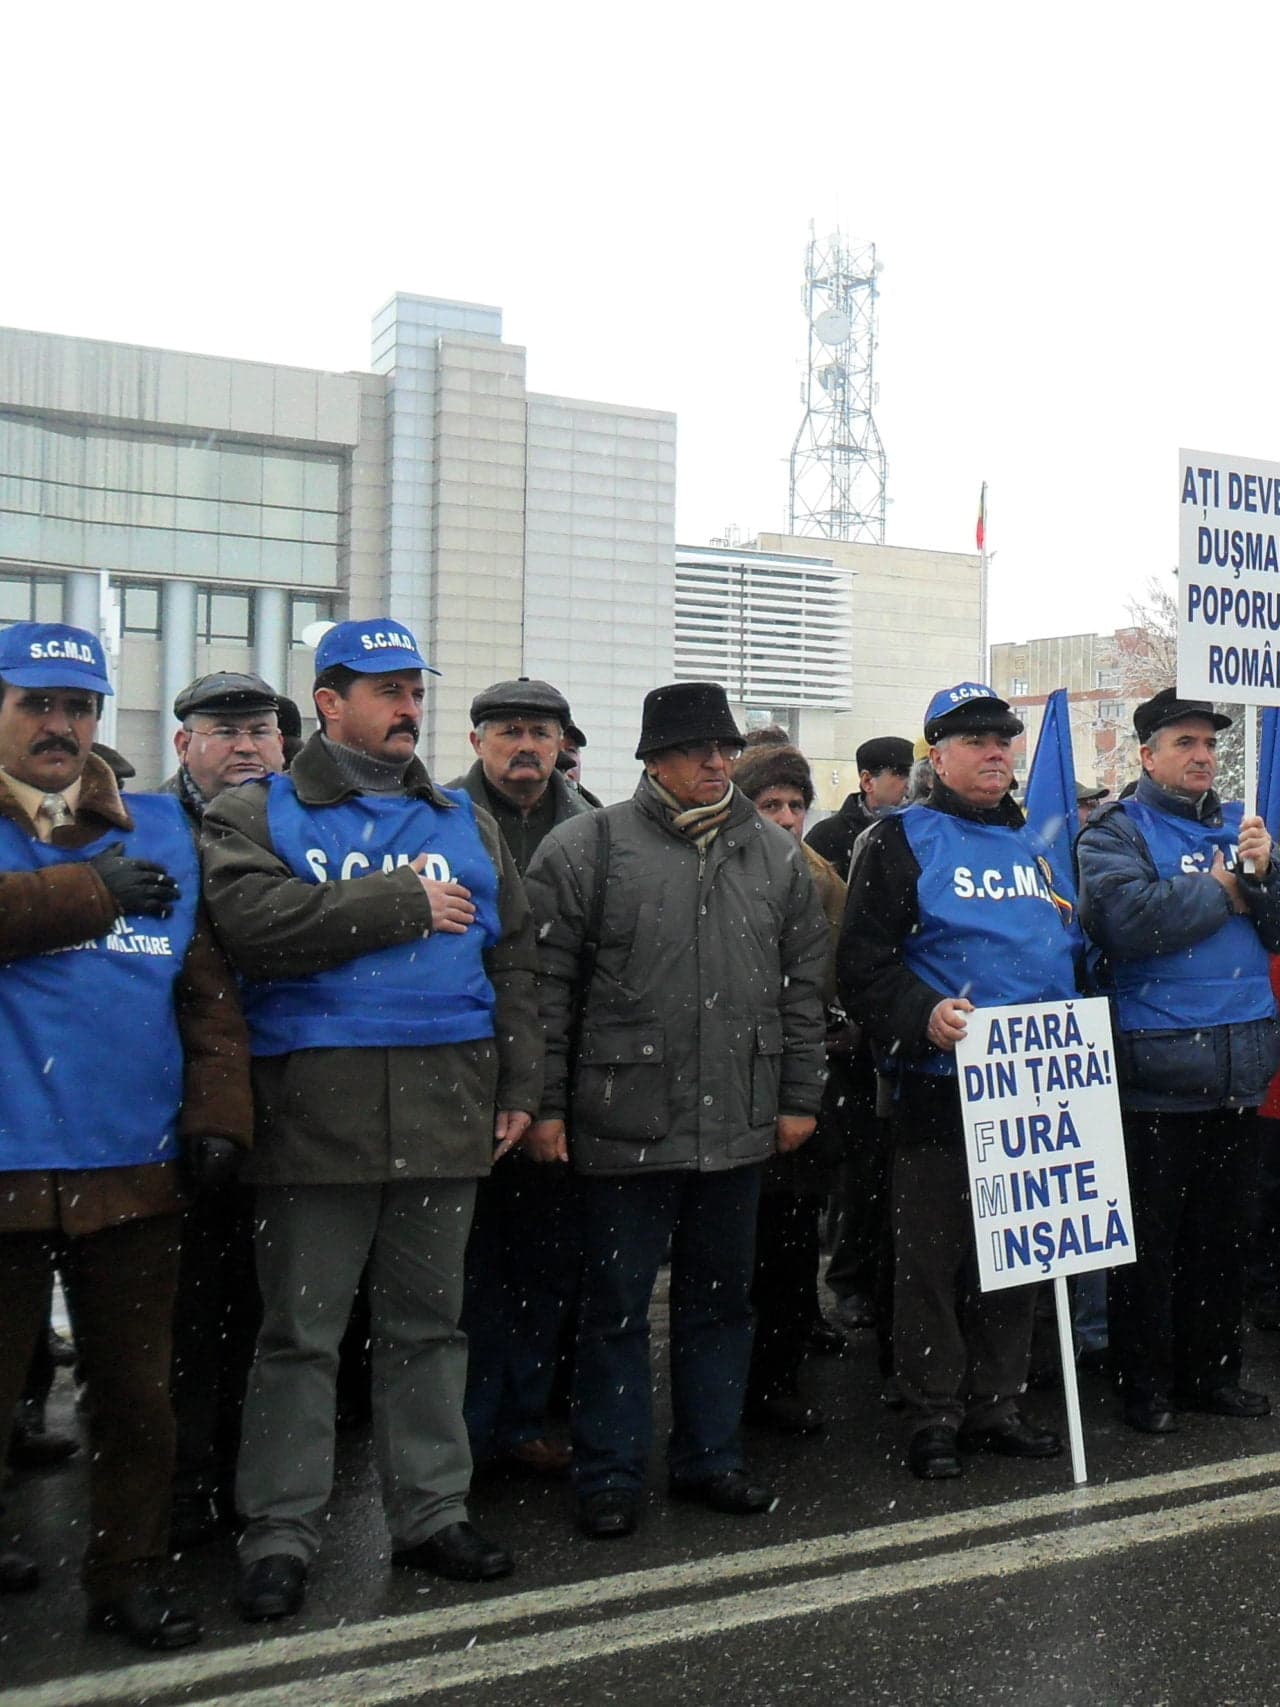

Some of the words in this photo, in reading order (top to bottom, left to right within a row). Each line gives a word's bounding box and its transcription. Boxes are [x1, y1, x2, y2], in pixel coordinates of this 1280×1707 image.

[1182, 466, 1219, 520] AȚI
[30, 640, 96, 665] S.C.M.D.
[362, 632, 415, 651] S.C.M.D.
[987, 1002, 1083, 1055] AFARĂ
[964, 1060, 1018, 1102] DIN
[1025, 1042, 1112, 1107] ȚARĂ!
[974, 1100, 1081, 1162] FURĂ
[976, 1160, 1098, 1218] MINTE
[992, 1199, 1129, 1274] INŞALĂ
